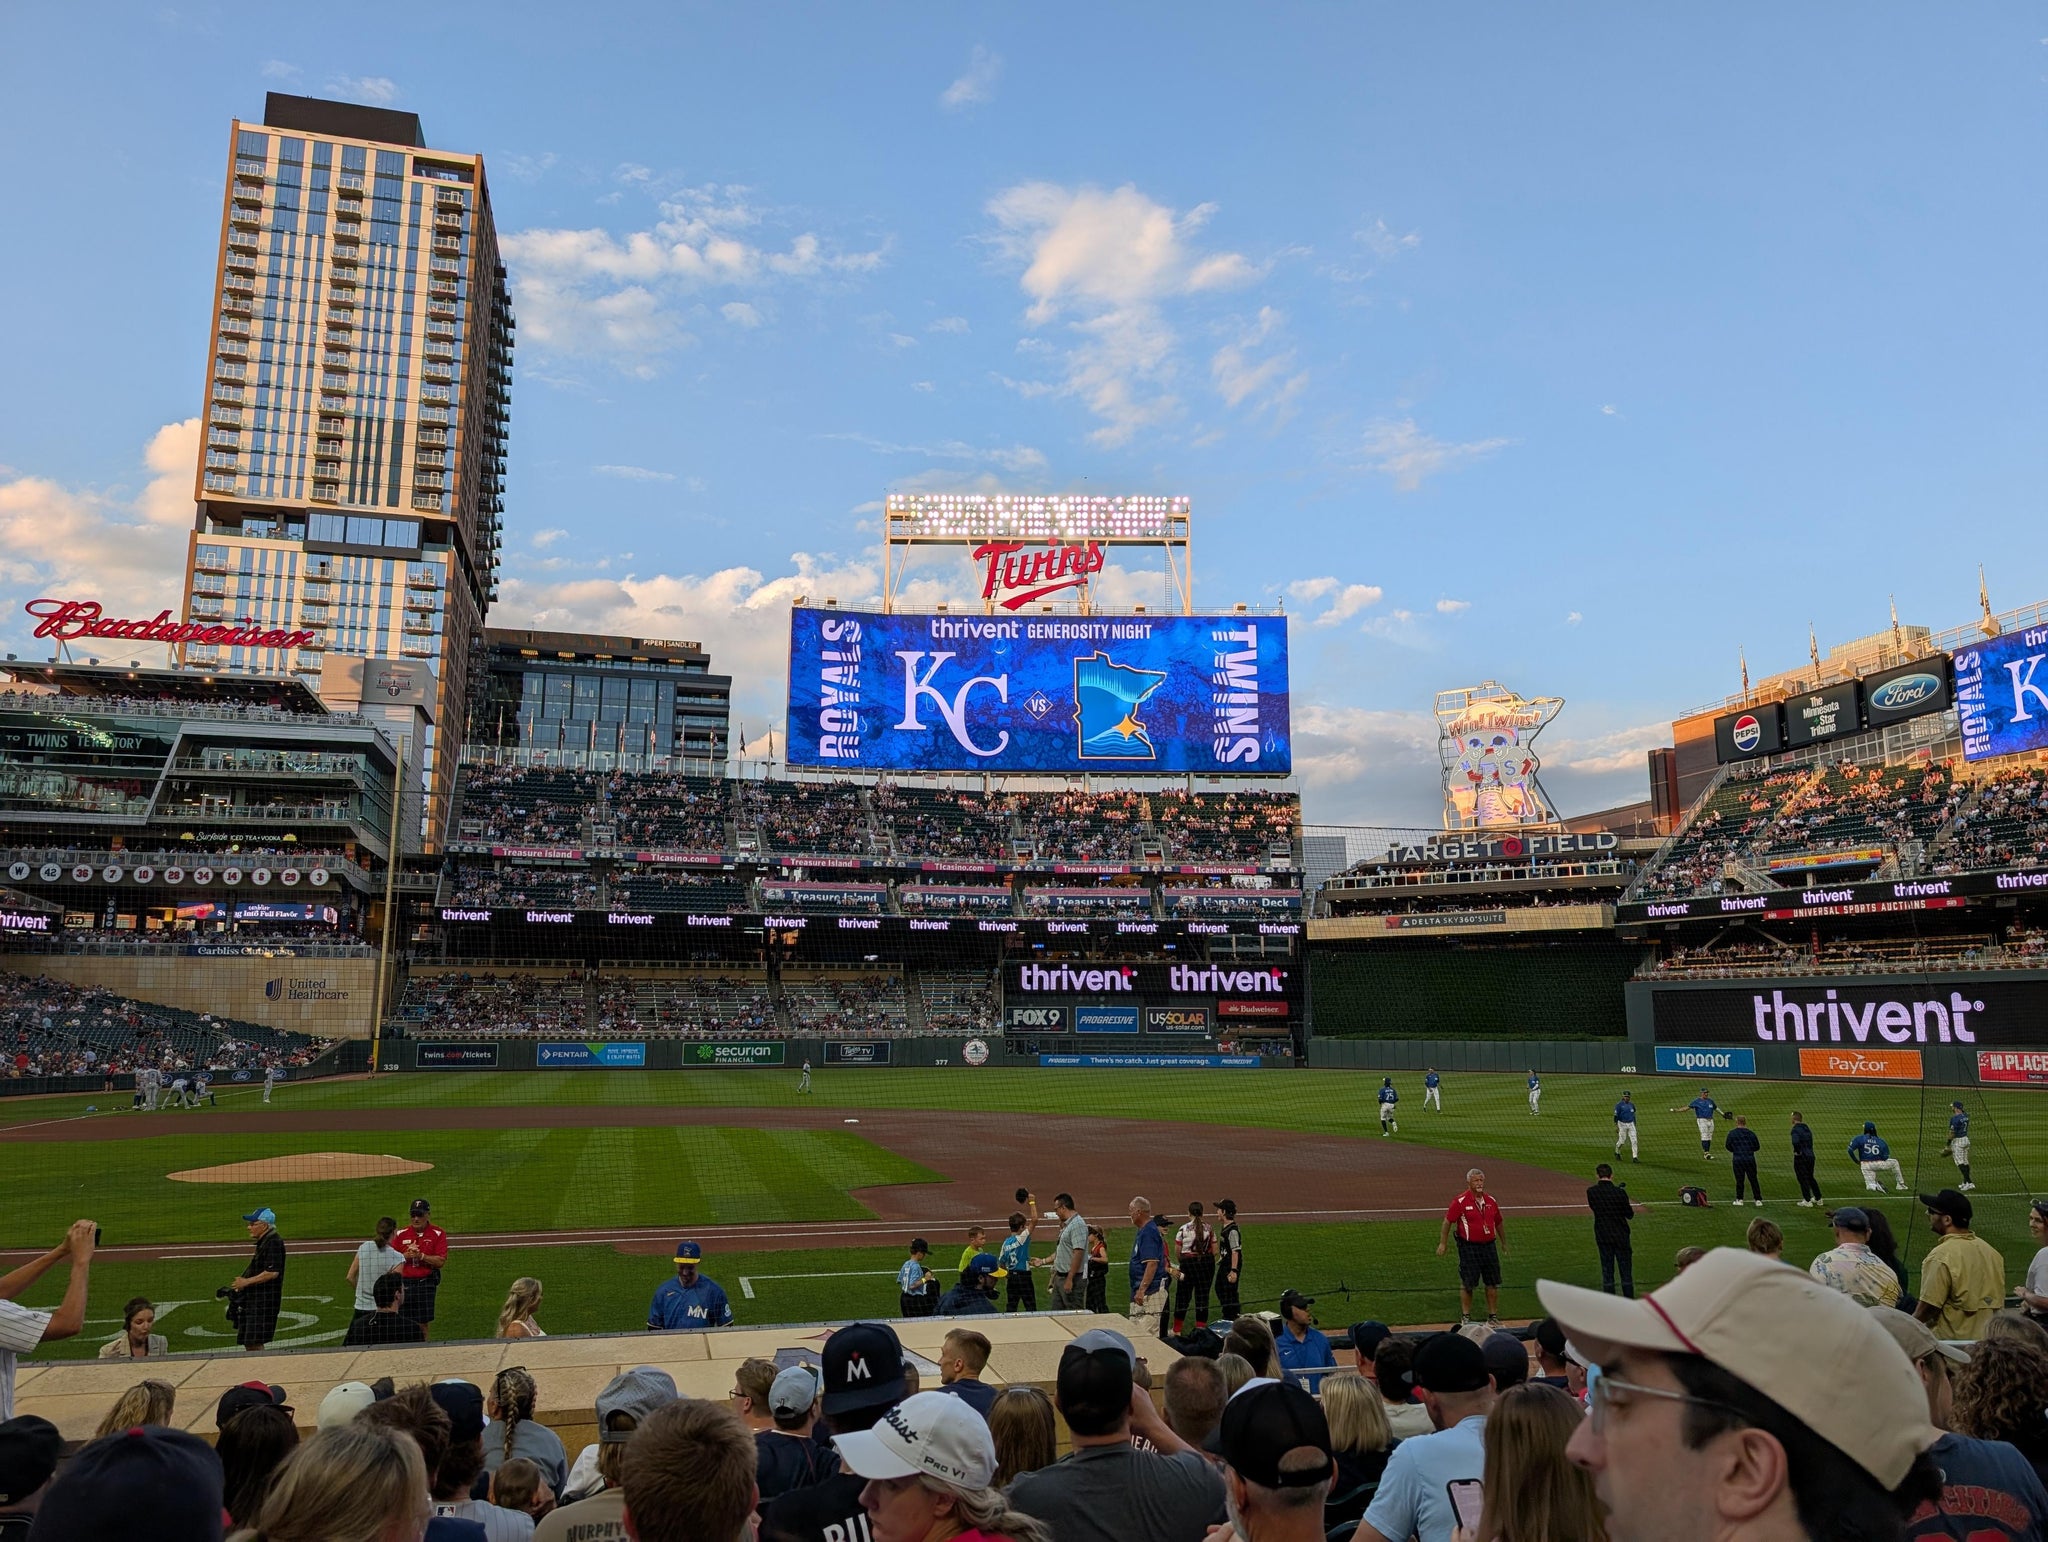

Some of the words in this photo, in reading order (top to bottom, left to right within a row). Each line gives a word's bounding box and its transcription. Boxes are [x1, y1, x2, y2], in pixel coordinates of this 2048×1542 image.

[973, 537, 1104, 611] Twins
[25, 599, 316, 649] Budweiser
[1027, 624, 1109, 639] GENEROSITY
[1112, 624, 1152, 640] NIGHT
[643, 639, 664, 647] PIPER
[667, 641, 697, 649] SANDLER
[819, 619, 862, 759] ROYALS
[1212, 624, 1260, 764] TWINS
[1884, 679, 1926, 705] Ford
[894, 651, 1010, 758] KC
[1031, 699, 1046, 712] VS
[1809, 696, 1823, 708] The
[1955, 651, 1991, 755] ROYALS
[1803, 701, 1840, 719] Minnesota
[1484, 708, 1541, 727] Twins!
[1819, 713, 1836, 725] Star
[1735, 728, 1759, 739] PEPSI
[1809, 723, 1837, 737] Tribune
[27, 733, 69, 748] TWINS
[502, 849, 543, 858] Treasure
[545, 850, 573, 858] Island
[1388, 841, 1497, 862] TARGET
[1529, 833, 1618, 854] FIELD
[790, 858, 827, 867] Treasure
[828, 859, 853, 868] Island
[1063, 865, 1097, 873] Treasure
[1099, 865, 1123, 873] Island
[1894, 880, 1949, 897] thrivent
[1803, 889, 1852, 904] thrivent
[1721, 896, 1765, 911] thrivent
[442, 909, 490, 921] thrivent
[1648, 902, 1687, 918] thrivent
[1793, 905, 1840, 918] UNIVERSAL
[1843, 902, 1877, 914] SPORTS
[0, 910, 48, 930] hrivent
[526, 911, 573, 923] thrivent
[608, 913, 653, 925] thrivent
[688, 914, 732, 926] thrivent
[764, 916, 806, 928] thrivent
[1412, 917, 1441, 925] DELTA
[838, 918, 879, 929] thrivent
[910, 920, 948, 930] thrivent
[979, 921, 1017, 932] thrivent
[1048, 922, 1086, 932] thrivent
[1118, 922, 1157, 933] thrivent
[1188, 923, 1227, 933] thrivent
[1259, 923, 1298, 934] thrivent
[198, 946, 239, 956] Carbliss
[1021, 963, 1133, 992] thrivent
[1170, 964, 1284, 993] thrivent
[289, 979, 327, 989] United
[288, 989, 349, 1000] Healthcare
[1240, 1005, 1279, 1013] Budweiser
[1013, 1009, 1047, 1026] FOX
[1048, 1009, 1061, 1025] 9
[1079, 1015, 1135, 1024] PROGRESSIVE
[715, 1046, 771, 1056] securian
[1676, 1052, 1731, 1069] uponor
[1828, 1052, 1888, 1074] Paycor
[2005, 1054, 2048, 1071] PLACE
[383, 1063, 399, 1071] 339
[1621, 1065, 1637, 1073] 403
[1863, 1143, 1880, 1155] 56
[687, 1304, 709, 1320] MN
[846, 1357, 872, 1383] M
[952, 1469, 967, 1481] V1
